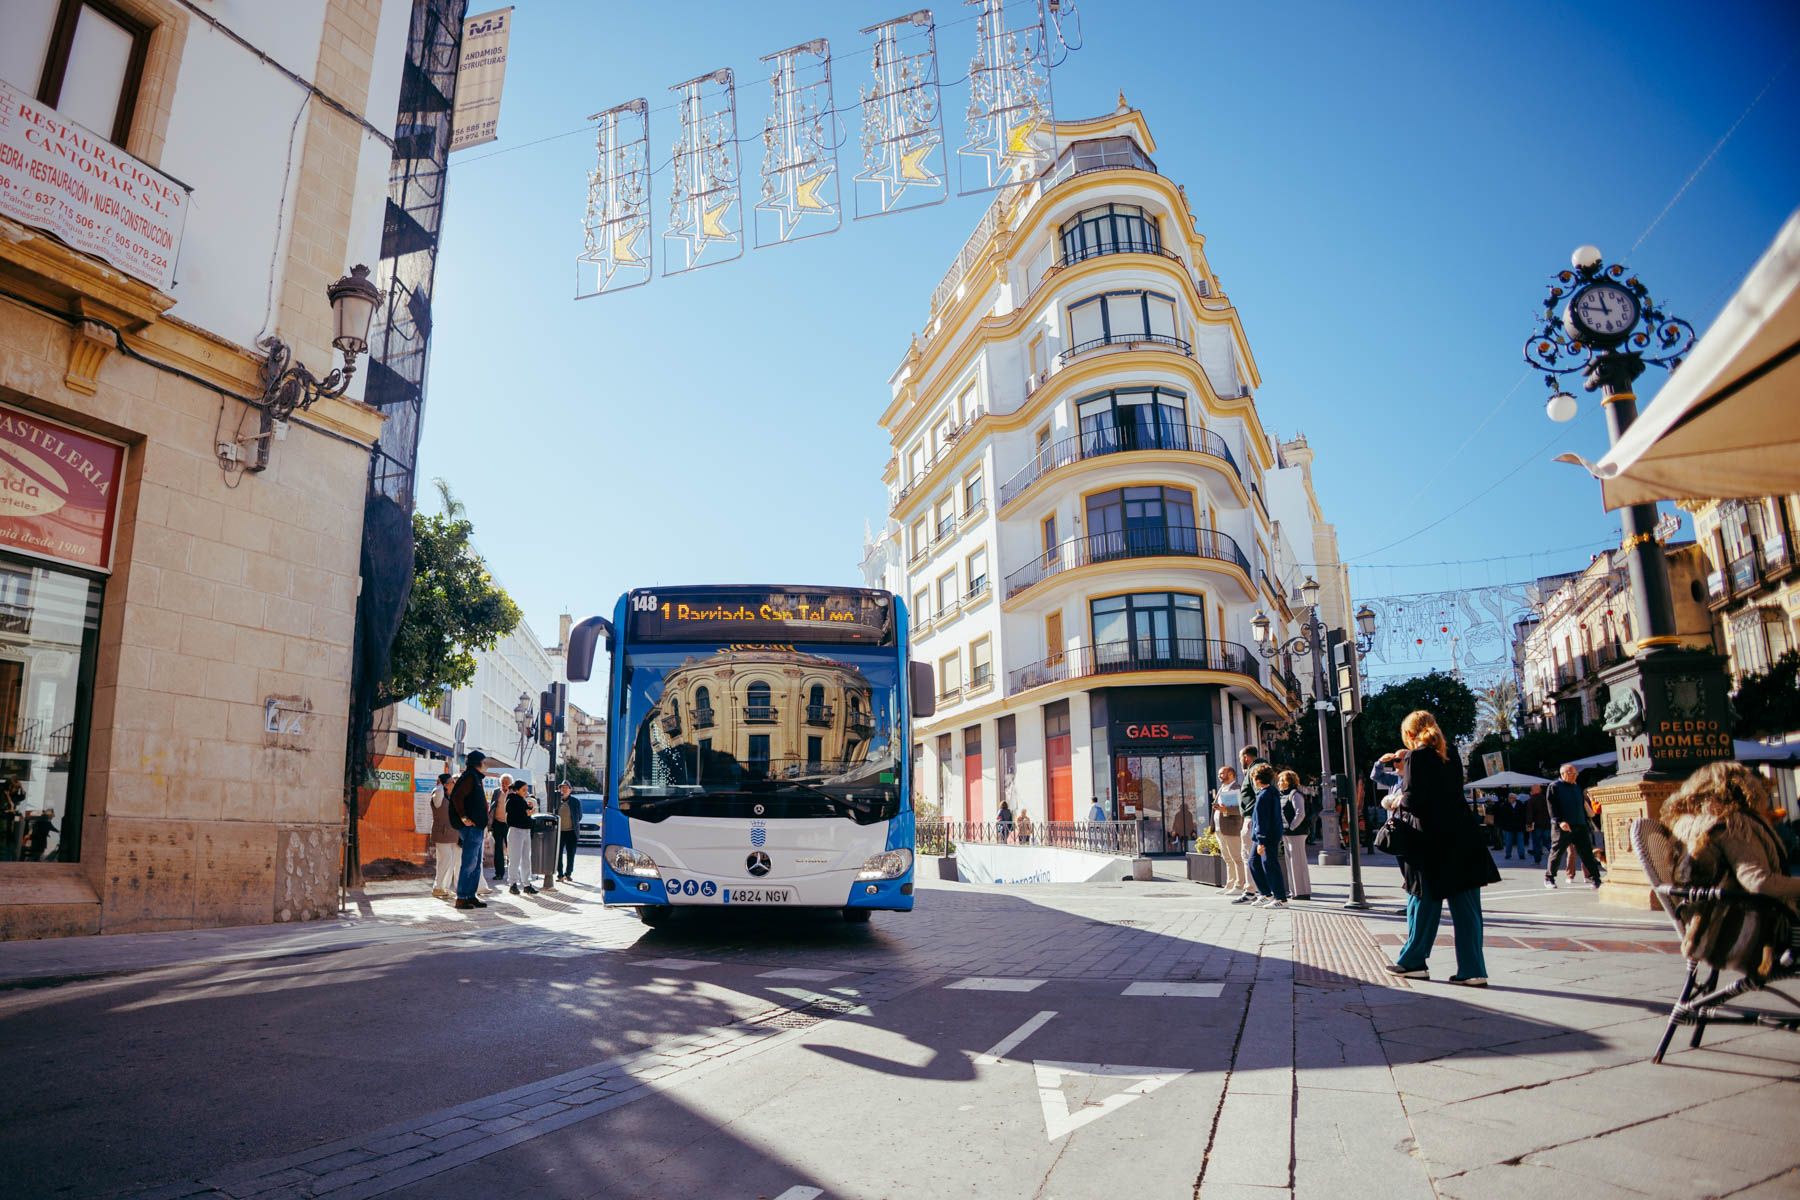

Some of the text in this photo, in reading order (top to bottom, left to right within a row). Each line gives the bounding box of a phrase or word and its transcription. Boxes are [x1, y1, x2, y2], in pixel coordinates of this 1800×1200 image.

[469, 16, 504, 36] MJ
[465, 47, 503, 60] ANDAMIOS
[459, 56, 506, 72] ESTRUCTURAS
[482, 120, 496, 128] 189
[19, 104, 181, 207] RESTAURACIONES
[25, 128, 169, 218] CANTOMAR, S.L.
[0, 142, 173, 251] IEDRA RESTAURACIÓN NUEVA CONSTRUCCIÓN
[35, 191, 56, 207] 637
[59, 200, 74, 220] 715
[75, 213, 94, 230] 506
[115, 232, 130, 249] 605
[132, 243, 149, 259] 078
[151, 253, 167, 269] 224
[21, 531, 55, 548] desde
[57, 540, 86, 556] 1980
[631, 595, 658, 612] 148
[660, 602, 670, 620] 1
[1126, 724, 1169, 739] GAES
[1660, 720, 1719, 733] PEDRO
[1652, 732, 1730, 749] DOMECQ
[731, 890, 788, 902] 4824 NGV
